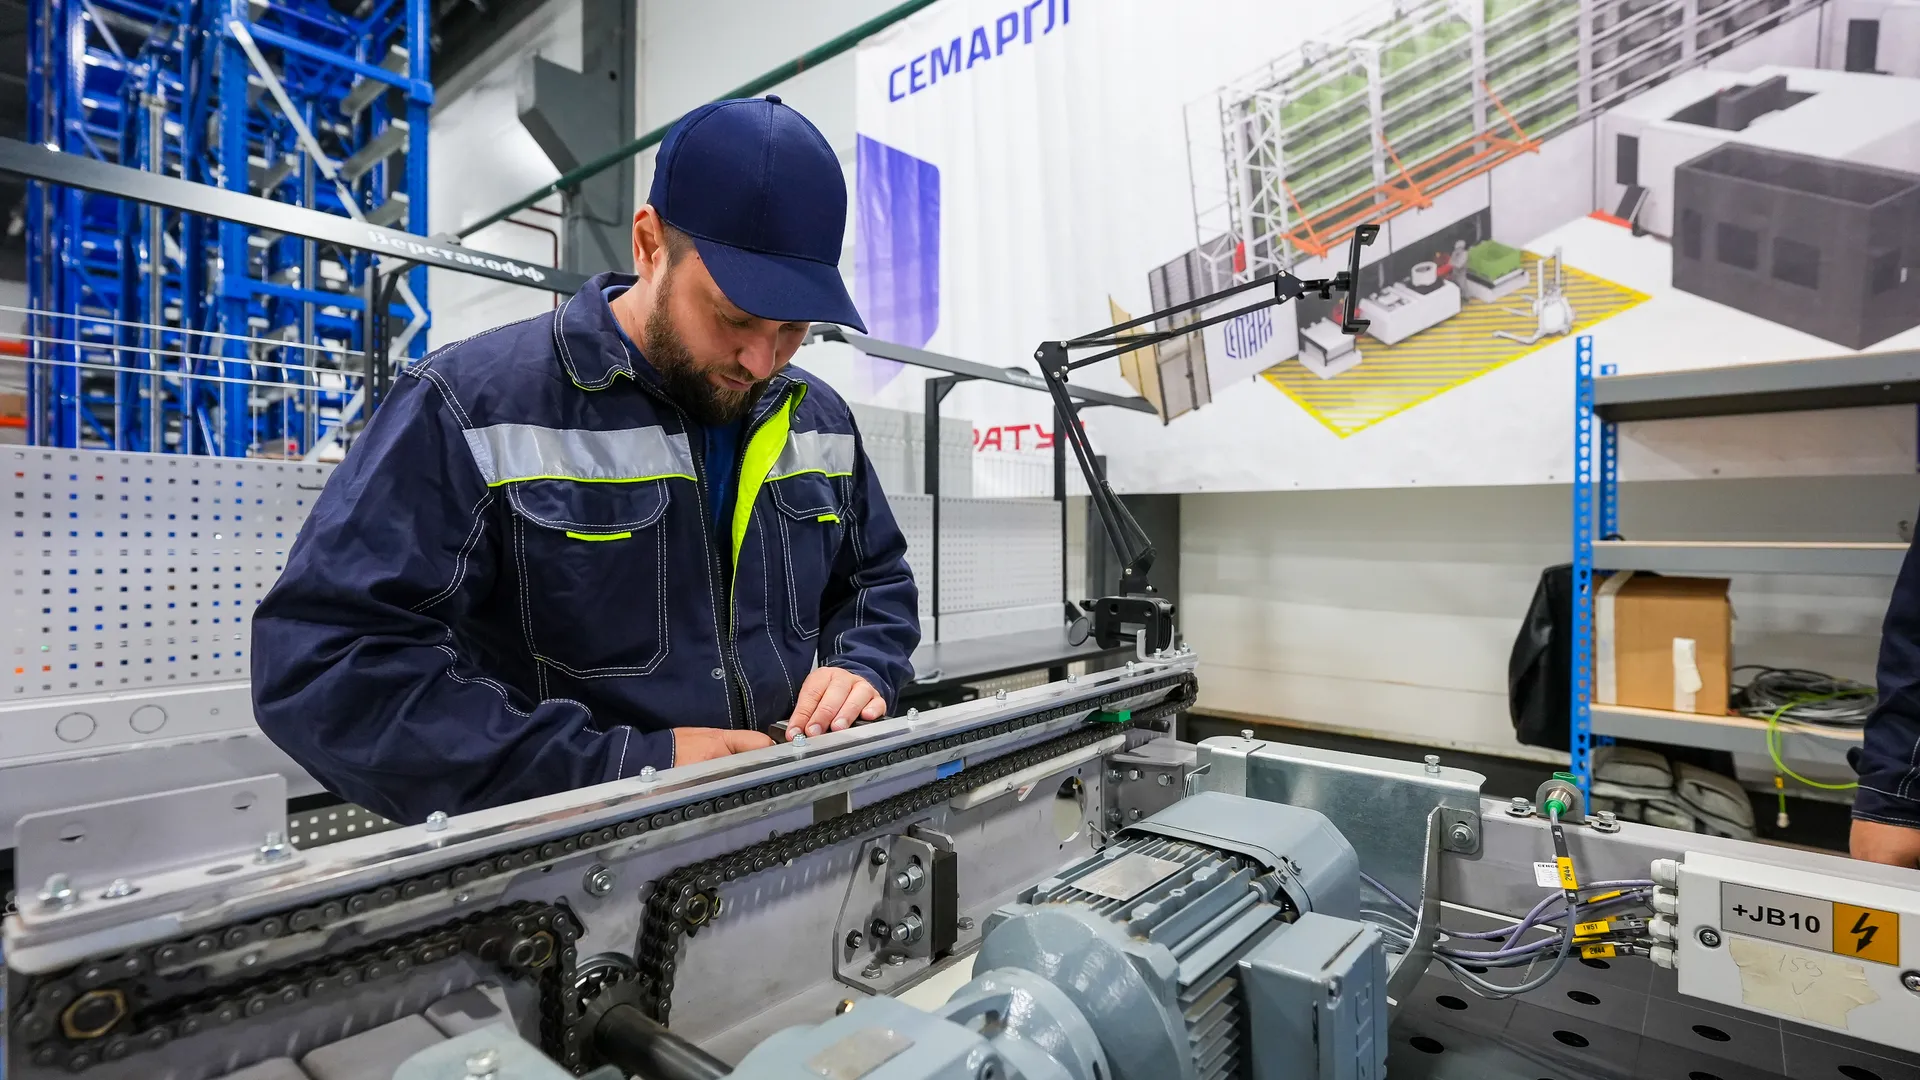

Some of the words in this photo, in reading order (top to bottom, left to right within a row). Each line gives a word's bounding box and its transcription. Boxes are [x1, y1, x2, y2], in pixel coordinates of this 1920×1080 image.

[367, 230, 546, 283] Верстакофф
[1562, 865, 1573, 882] 2W44
[1583, 923, 1599, 931] 1W51
[1732, 903, 1821, 934] +JB10
[1589, 946, 1606, 955] 2W44
